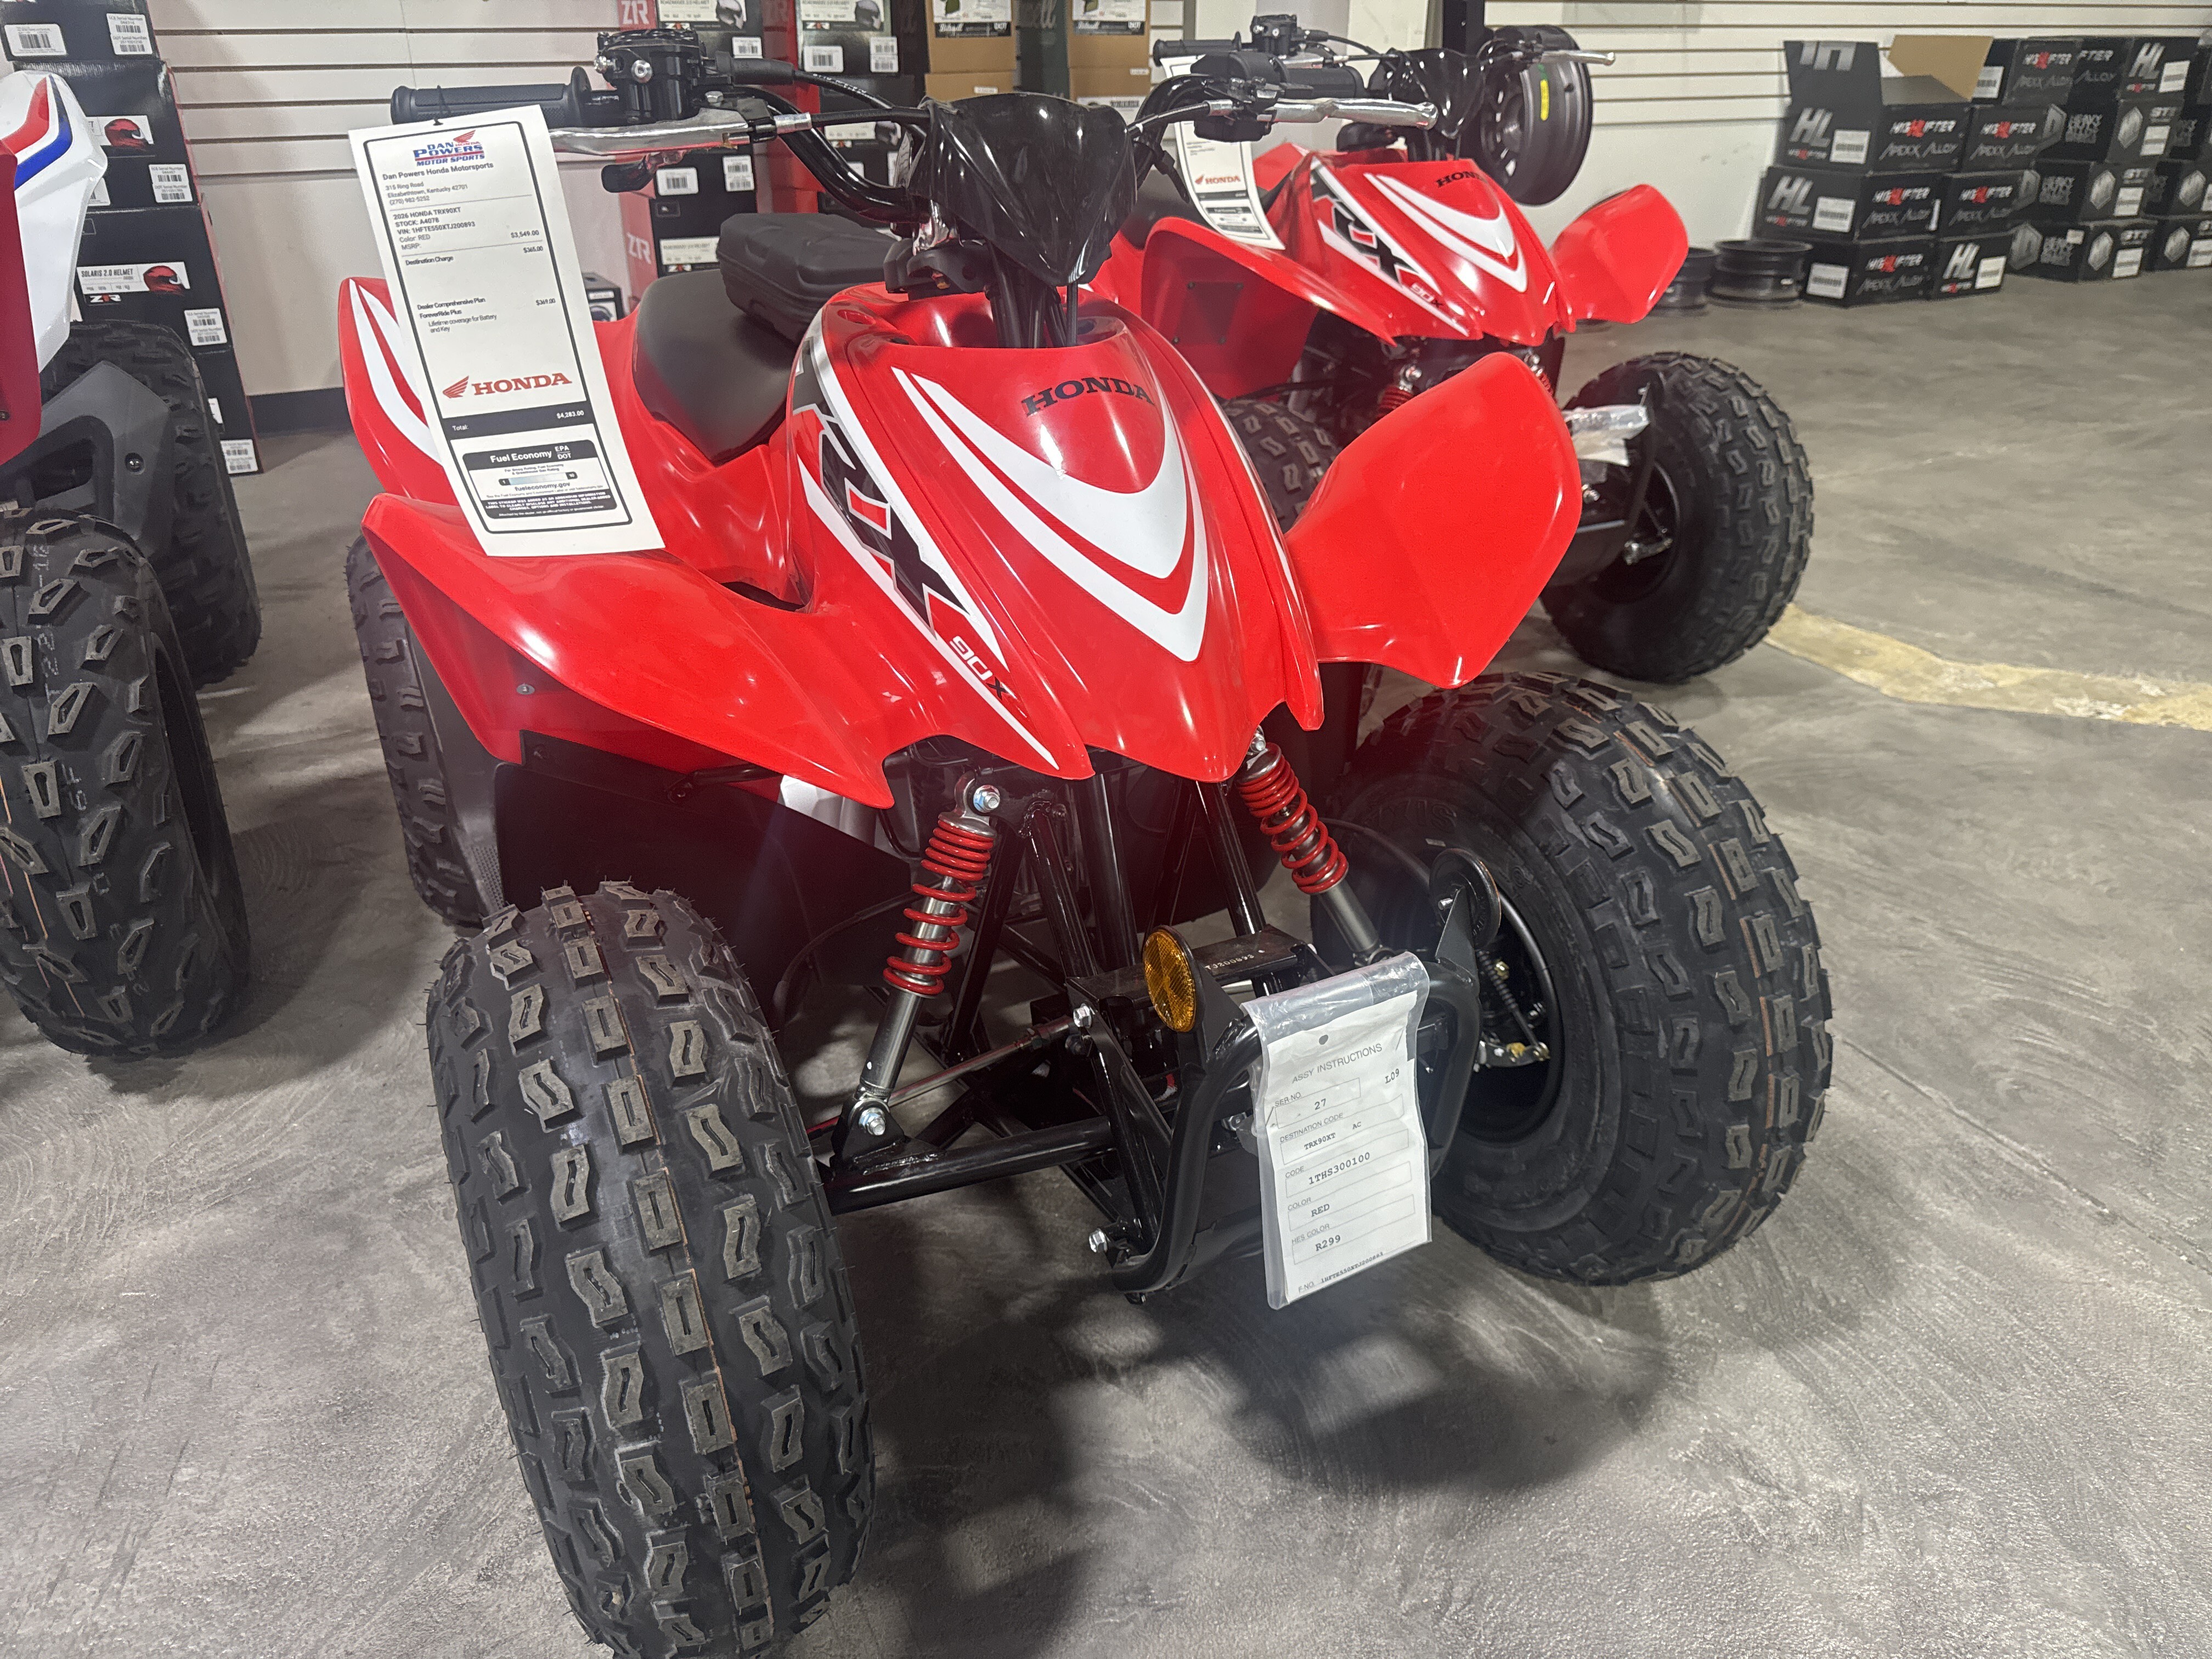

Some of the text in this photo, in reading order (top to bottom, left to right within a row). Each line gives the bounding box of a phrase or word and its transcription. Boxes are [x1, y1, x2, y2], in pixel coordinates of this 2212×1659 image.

[413, 144, 483, 158] POWERS
[427, 142, 454, 151] DAN
[416, 154, 485, 167] MOTOR SPORTS
[382, 162, 494, 181] Dan Powers Honda Motorsports
[1205, 175, 1241, 184] HONDA
[426, 186, 451, 194] Kentucky
[410, 210, 433, 218] HONDA
[433, 206, 461, 215] TRX90XT
[511, 229, 540, 239] $3,549.00
[405, 245, 544, 266] Destination Charge $365.00
[114, 268, 133, 276] HELMET
[434, 298, 474, 309] Comprehensive
[428, 319, 449, 328] Lifetime
[449, 317, 472, 326] coverage
[479, 313, 498, 322] Battery
[441, 325, 450, 333] Key
[471, 372, 573, 396] HONDA
[1020, 375, 1155, 418] HONDA
[556, 410, 585, 420] $4,283.00
[554, 444, 569, 453] EPA
[490, 449, 552, 464] Fuel Economy
[515, 482, 571, 492] fueleconomy.gov
[949, 633, 1011, 702] 90X
[1291, 1042, 1383, 1085] ASSY INSTRUCTIONS
[1384, 1068, 1400, 1085] L09
[1314, 1098, 1327, 1111] 27
[1280, 1112, 1344, 1143] DESTINATION CODE
[1304, 1121, 1362, 1150] TRX90XT AC
[1285, 1165, 1305, 1179] CODE
[1308, 1151, 1371, 1185] 1THS300100
[1287, 1197, 1312, 1211] COLOR
[1311, 1203, 1330, 1217] RED
[1291, 1223, 1330, 1245] HES COLOR
[1314, 1234, 1341, 1251] R299
